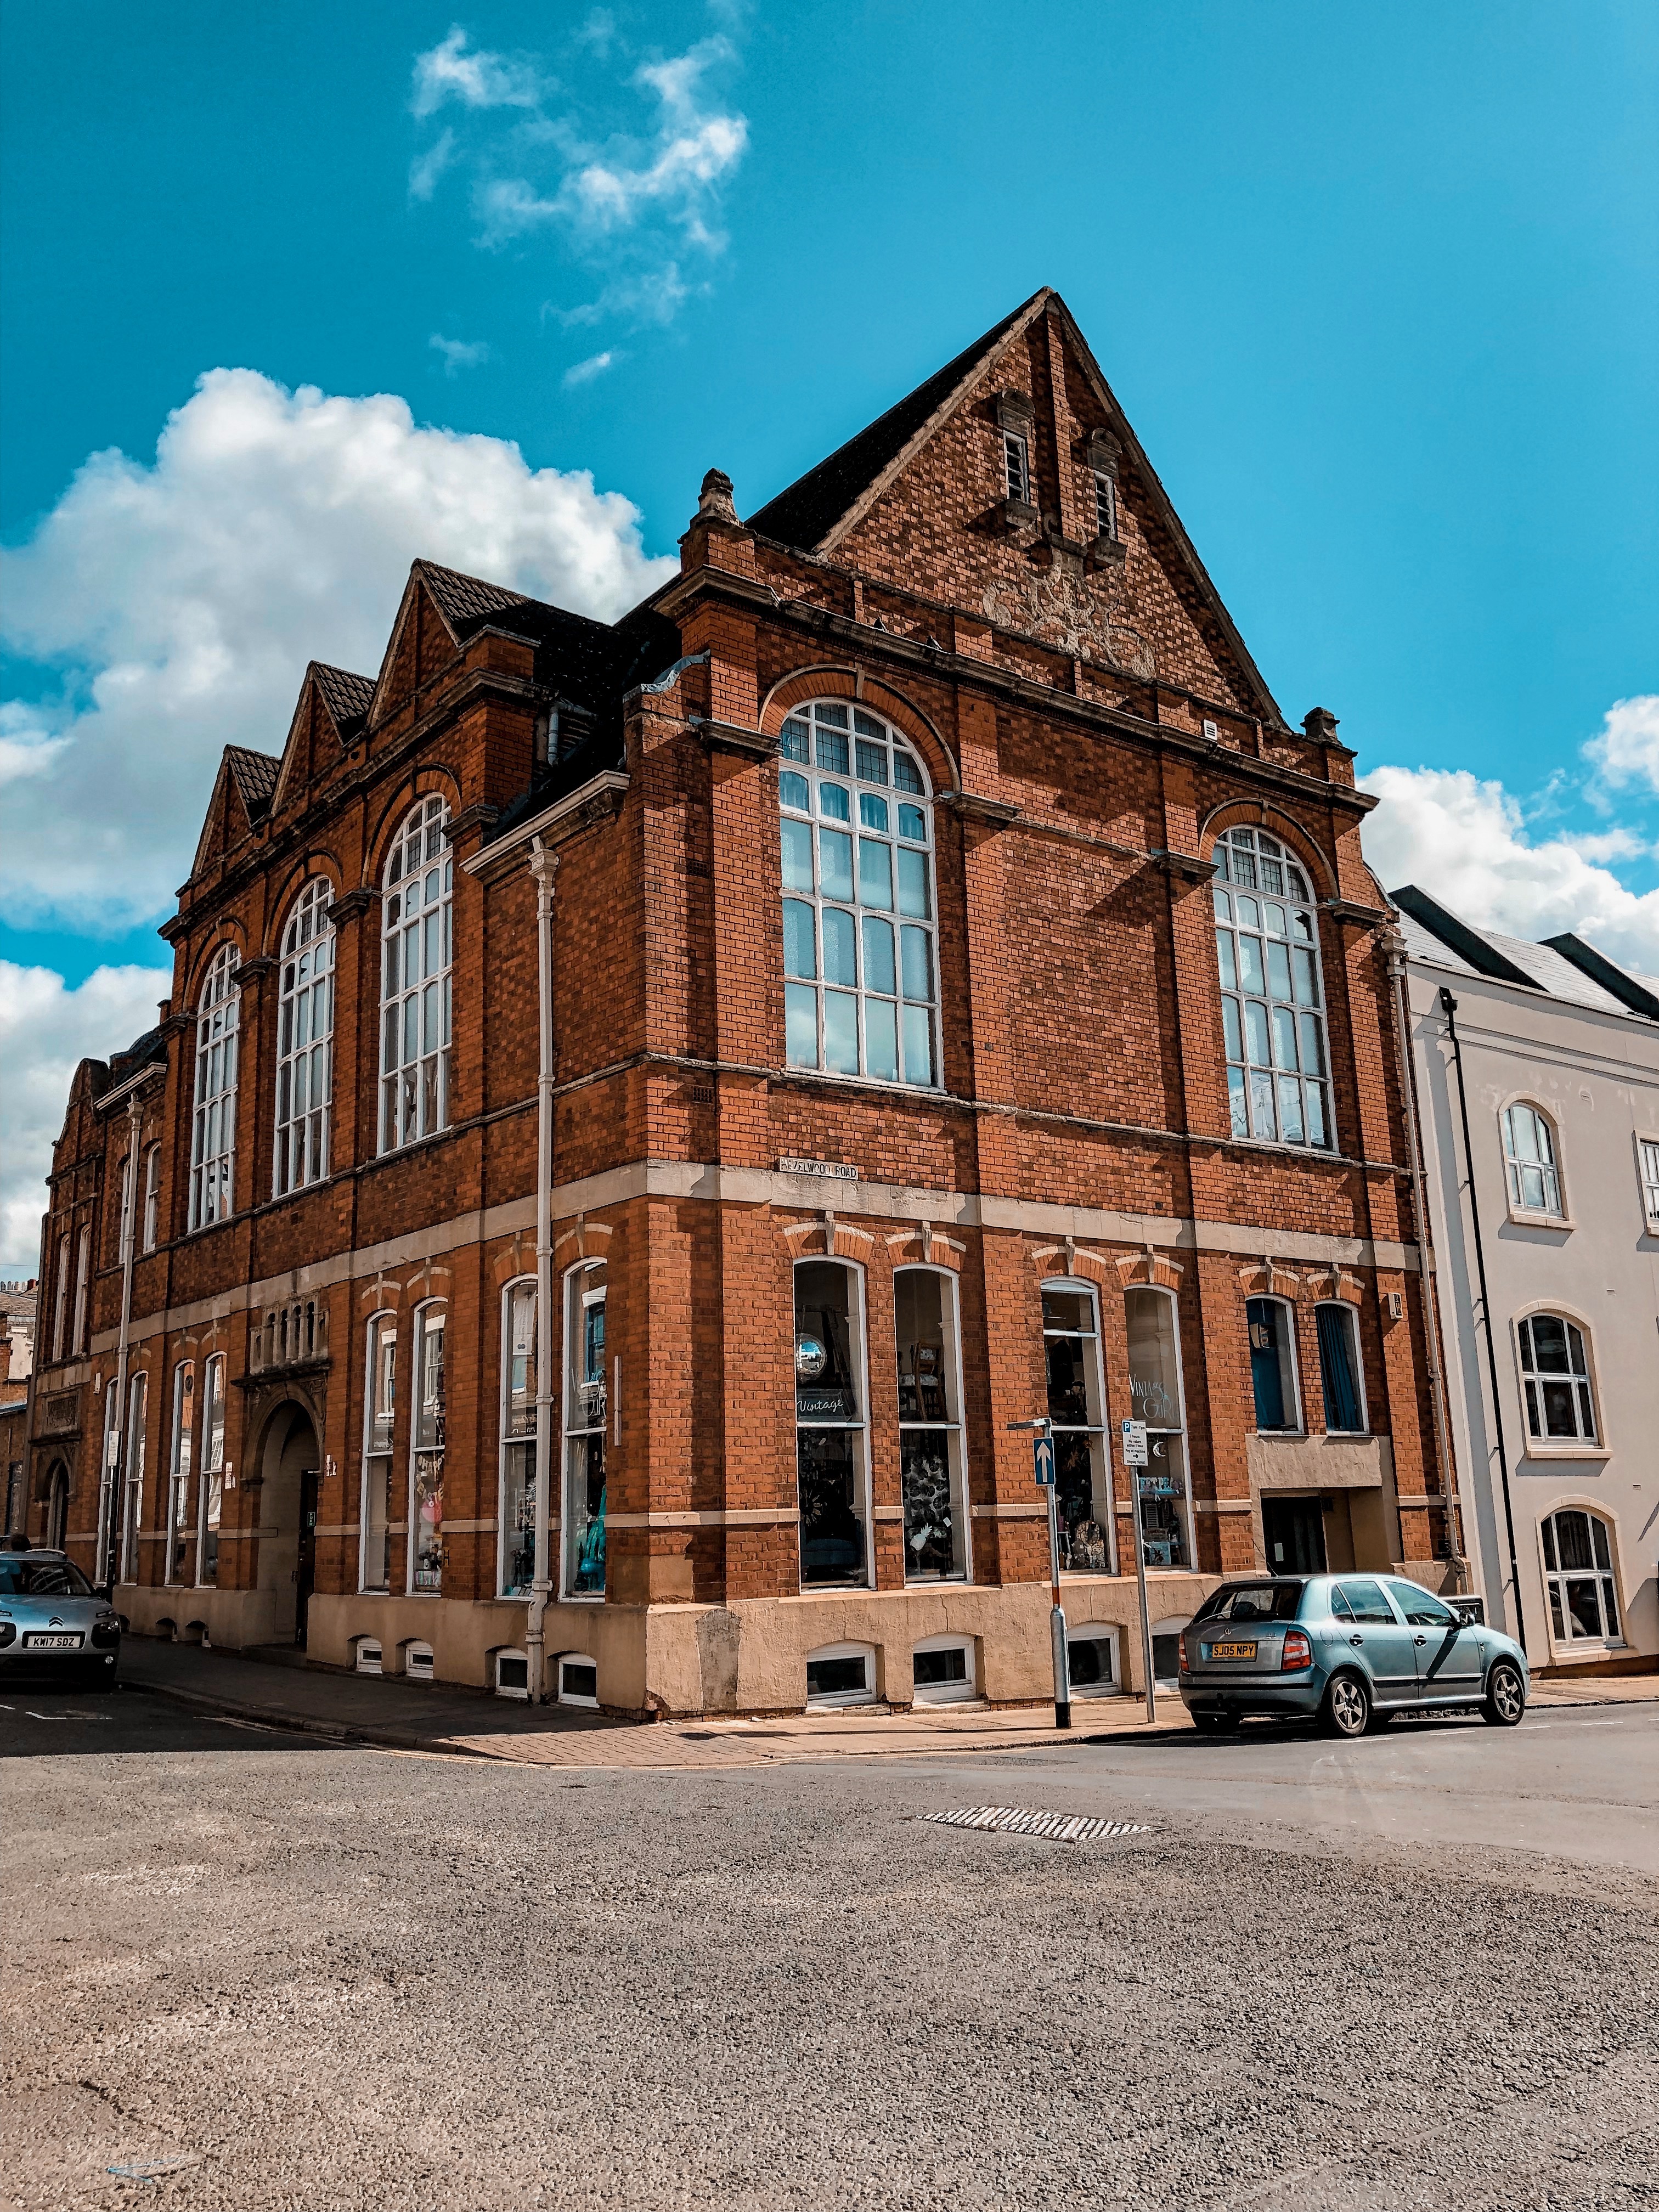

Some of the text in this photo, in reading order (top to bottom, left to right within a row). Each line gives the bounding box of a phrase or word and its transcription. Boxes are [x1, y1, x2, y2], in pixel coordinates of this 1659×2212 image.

[835, 1165, 856, 1178] ROAD
[797, 1399, 843, 1412] Vintage
[1125, 1423, 1130, 1431] P
[33, 1638, 75, 1646] KW17 SDZ
[1214, 1645, 1254, 1656] SJ05 NPY
